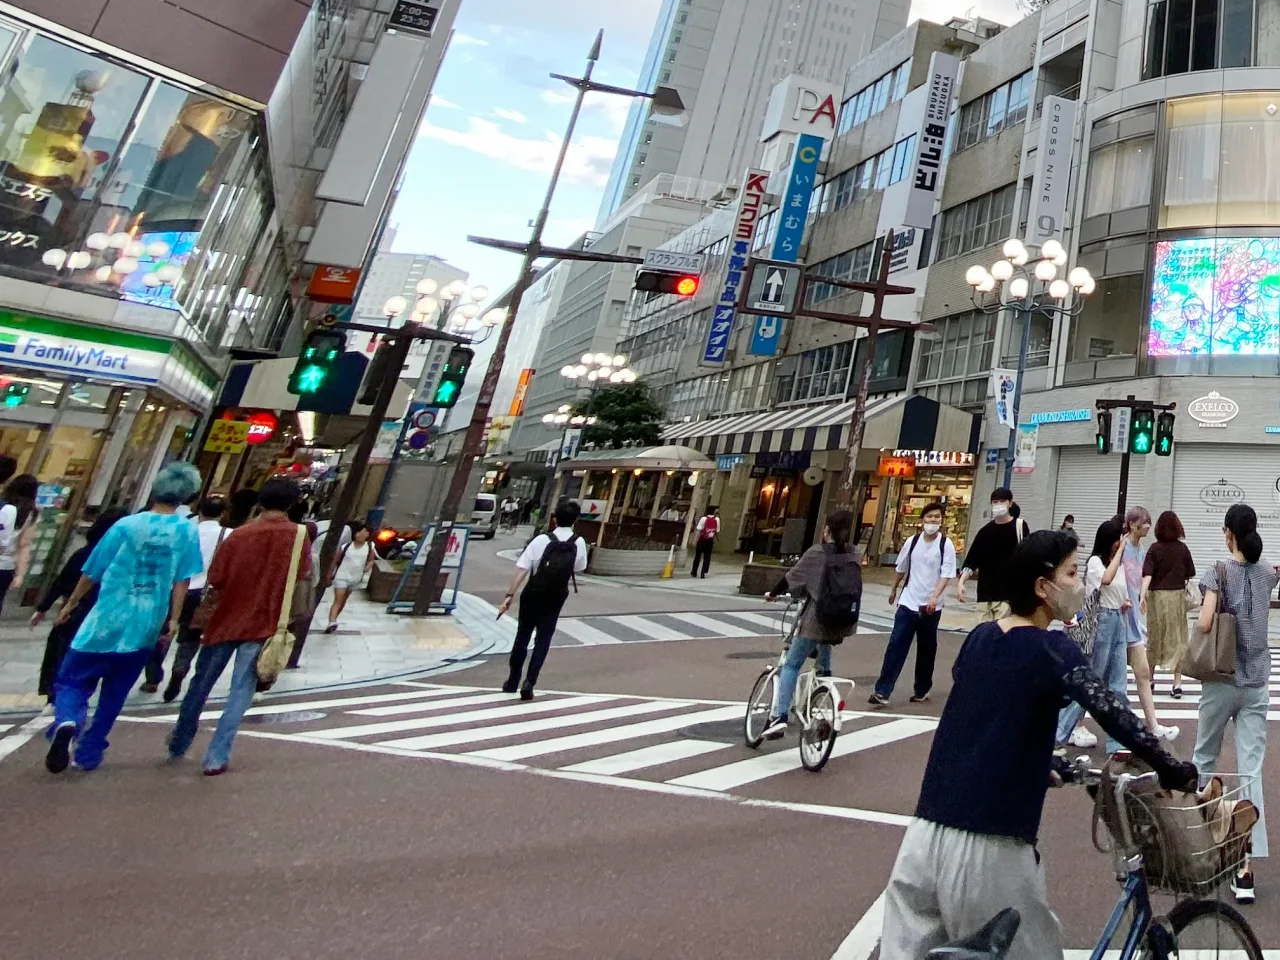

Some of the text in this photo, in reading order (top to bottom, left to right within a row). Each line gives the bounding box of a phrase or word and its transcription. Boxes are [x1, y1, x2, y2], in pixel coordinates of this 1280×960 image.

[400, 14, 430, 27] 23:30
[928, 73, 942, 118] BIRUPAKU
[936, 76, 951, 120] SHIZUOKA
[1042, 104, 1061, 203] CROSS NINE
[736, 194, 763, 239] コクヨ
[782, 174, 810, 252] いまむら
[648, 252, 700, 270] スクランブル式
[720, 241, 750, 302] 事務用品
[22, 338, 129, 370] FamilyMart
[1194, 403, 1234, 412] EXELCO
